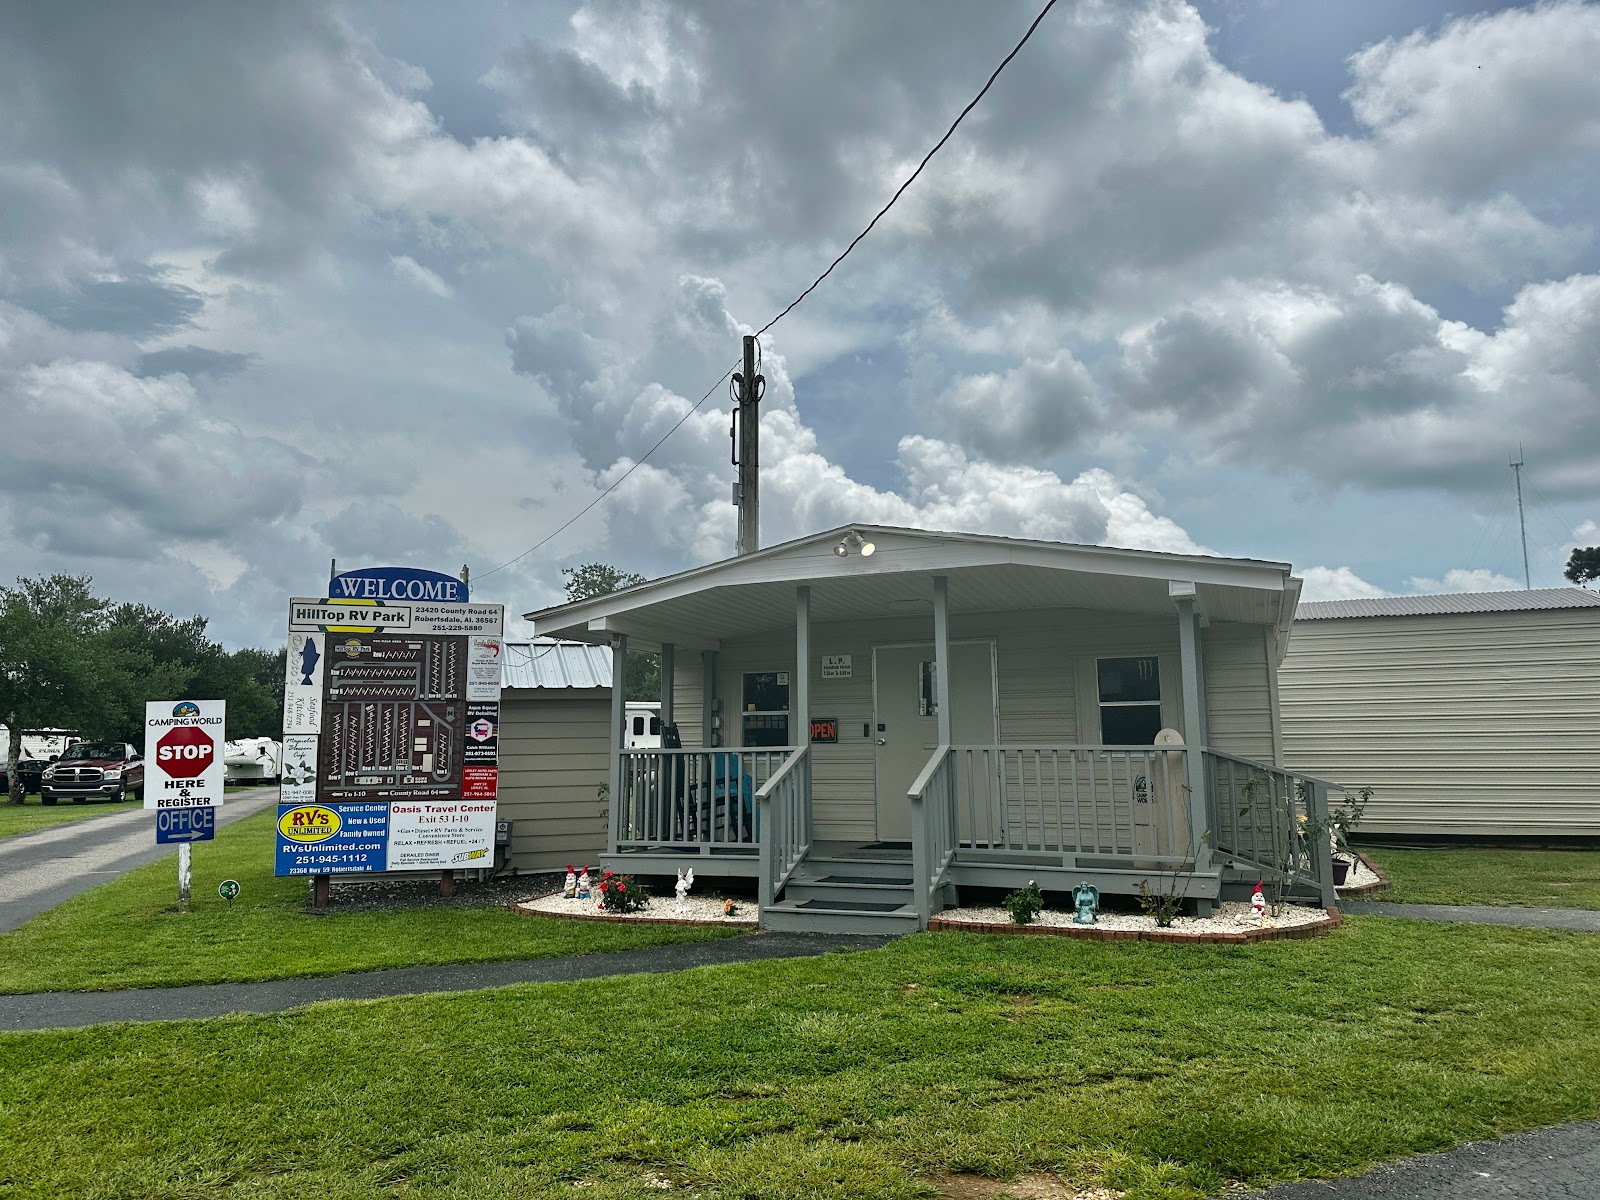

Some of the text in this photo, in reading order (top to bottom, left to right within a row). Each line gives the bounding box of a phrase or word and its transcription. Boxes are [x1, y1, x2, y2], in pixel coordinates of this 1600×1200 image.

[338, 577, 458, 600] WELCOME
[296, 608, 405, 622] HillTop RV Park
[416, 606, 439, 614] 23420
[440, 607, 466, 615] County
[295, 696, 305, 726] Kitchen
[306, 696, 318, 728] Seafood
[148, 717, 222, 726] CAMPING WORLD
[158, 744, 212, 760] STOP
[164, 780, 206, 789] HERE
[178, 789, 191, 797] &
[158, 797, 211, 807] REGISTER
[365, 804, 388, 812] Center
[392, 804, 494, 814] Oasis Travel Center
[158, 808, 212, 831] OFFICE
[293, 810, 329, 825] RV's
[439, 815, 449, 823] 53
[451, 815, 469, 823] I-10
[288, 826, 332, 835] UNLIMITED
[340, 830, 362, 838] Family
[282, 843, 380, 852] RVsUnlimited.com
[296, 854, 368, 864] 251-945-1112
[452, 848, 489, 863] SUBWAY
